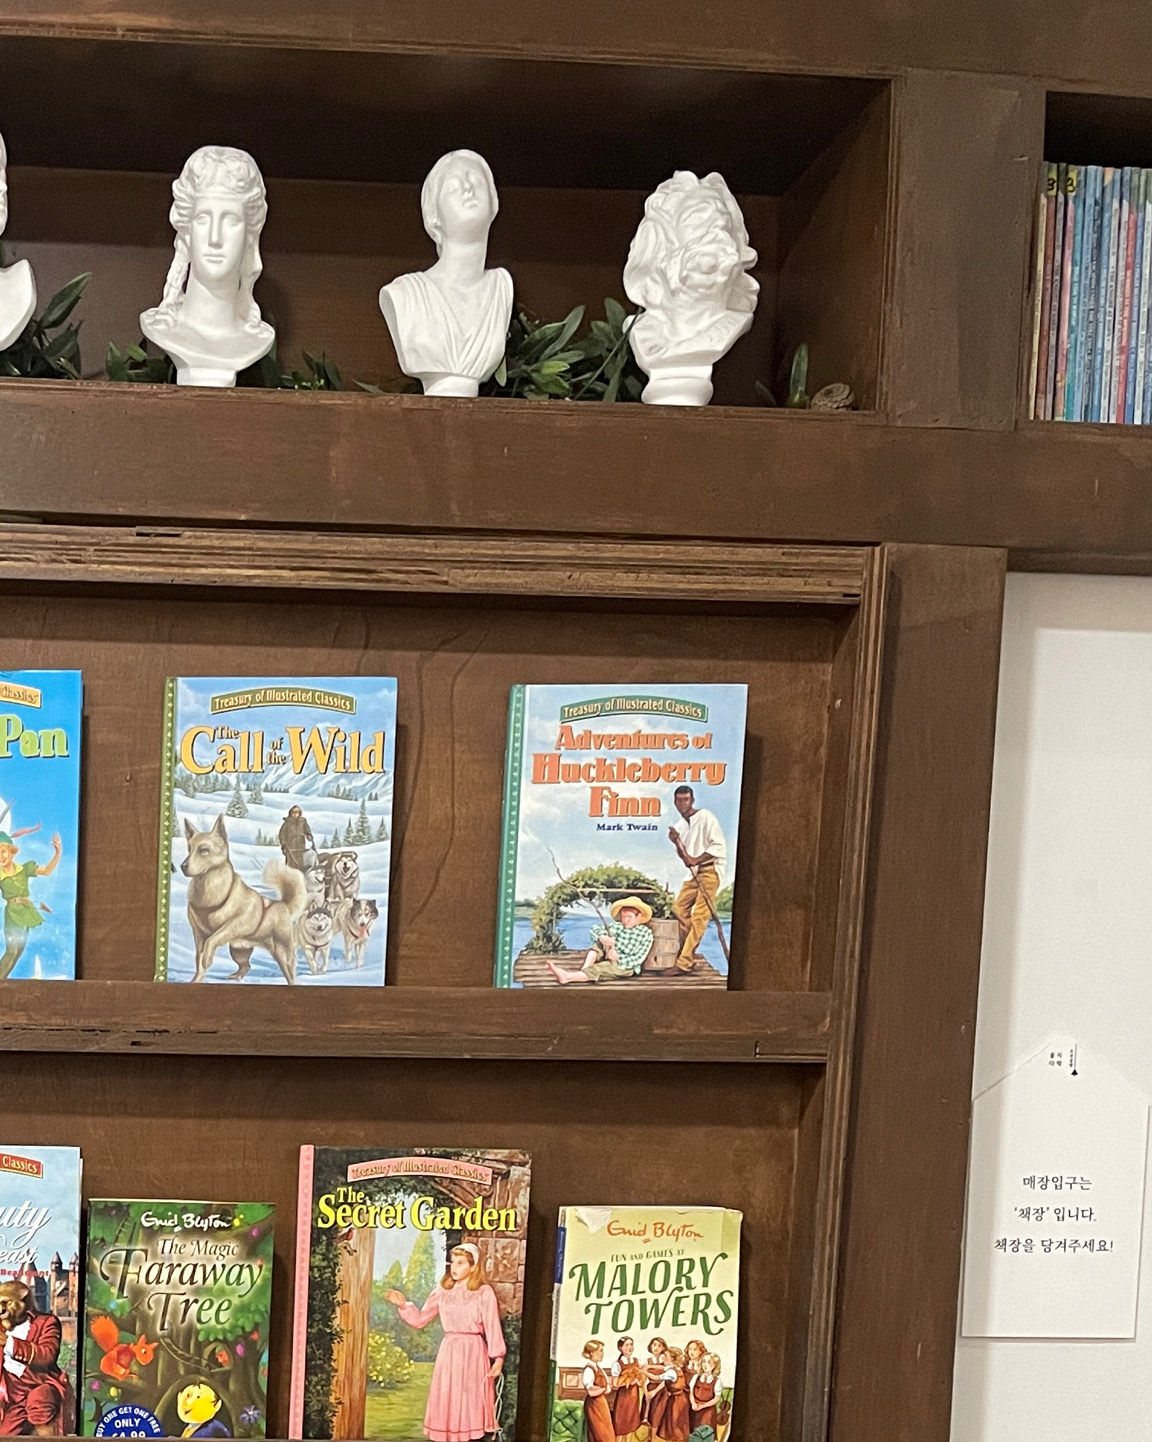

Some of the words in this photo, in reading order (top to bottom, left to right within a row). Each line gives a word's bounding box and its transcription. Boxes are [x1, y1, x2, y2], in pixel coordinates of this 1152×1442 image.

[215, 725, 240, 740] The
[555, 725, 690, 750] Adventures
[692, 732, 712, 750] of
[179, 725, 265, 775] Call
[266, 752, 287, 765] the
[286, 726, 385, 775] Wild
[531, 751, 727, 785] Huckleberry
[588, 785, 661, 818] Finn
[3, 1156, 38, 1174] Classics
[336, 1187, 364, 1203] The
[1022, 1175, 1092, 1191] 매장입구는
[317, 1194, 406, 1229] Secret
[410, 1195, 518, 1231] Garden
[1054, 1206, 1097, 1222] 입니다.
[157, 1237, 186, 1255] The
[191, 1239, 239, 1261] Magic
[611, 1254, 626, 1262] FUN
[646, 1249, 673, 1259] GAMES
[994, 1238, 1036, 1253] 책장을
[1040, 1238, 1114, 1253] 당겨주세요!
[99, 1248, 263, 1300] Faraway
[568, 1252, 728, 1301] MALORY
[147, 1292, 233, 1332] Tree
[583, 1286, 734, 1336] TOWERS
[114, 1418, 141, 1428] ONLY
[134, 1408, 149, 1419] ONE
[147, 1416, 161, 1433] FREE
